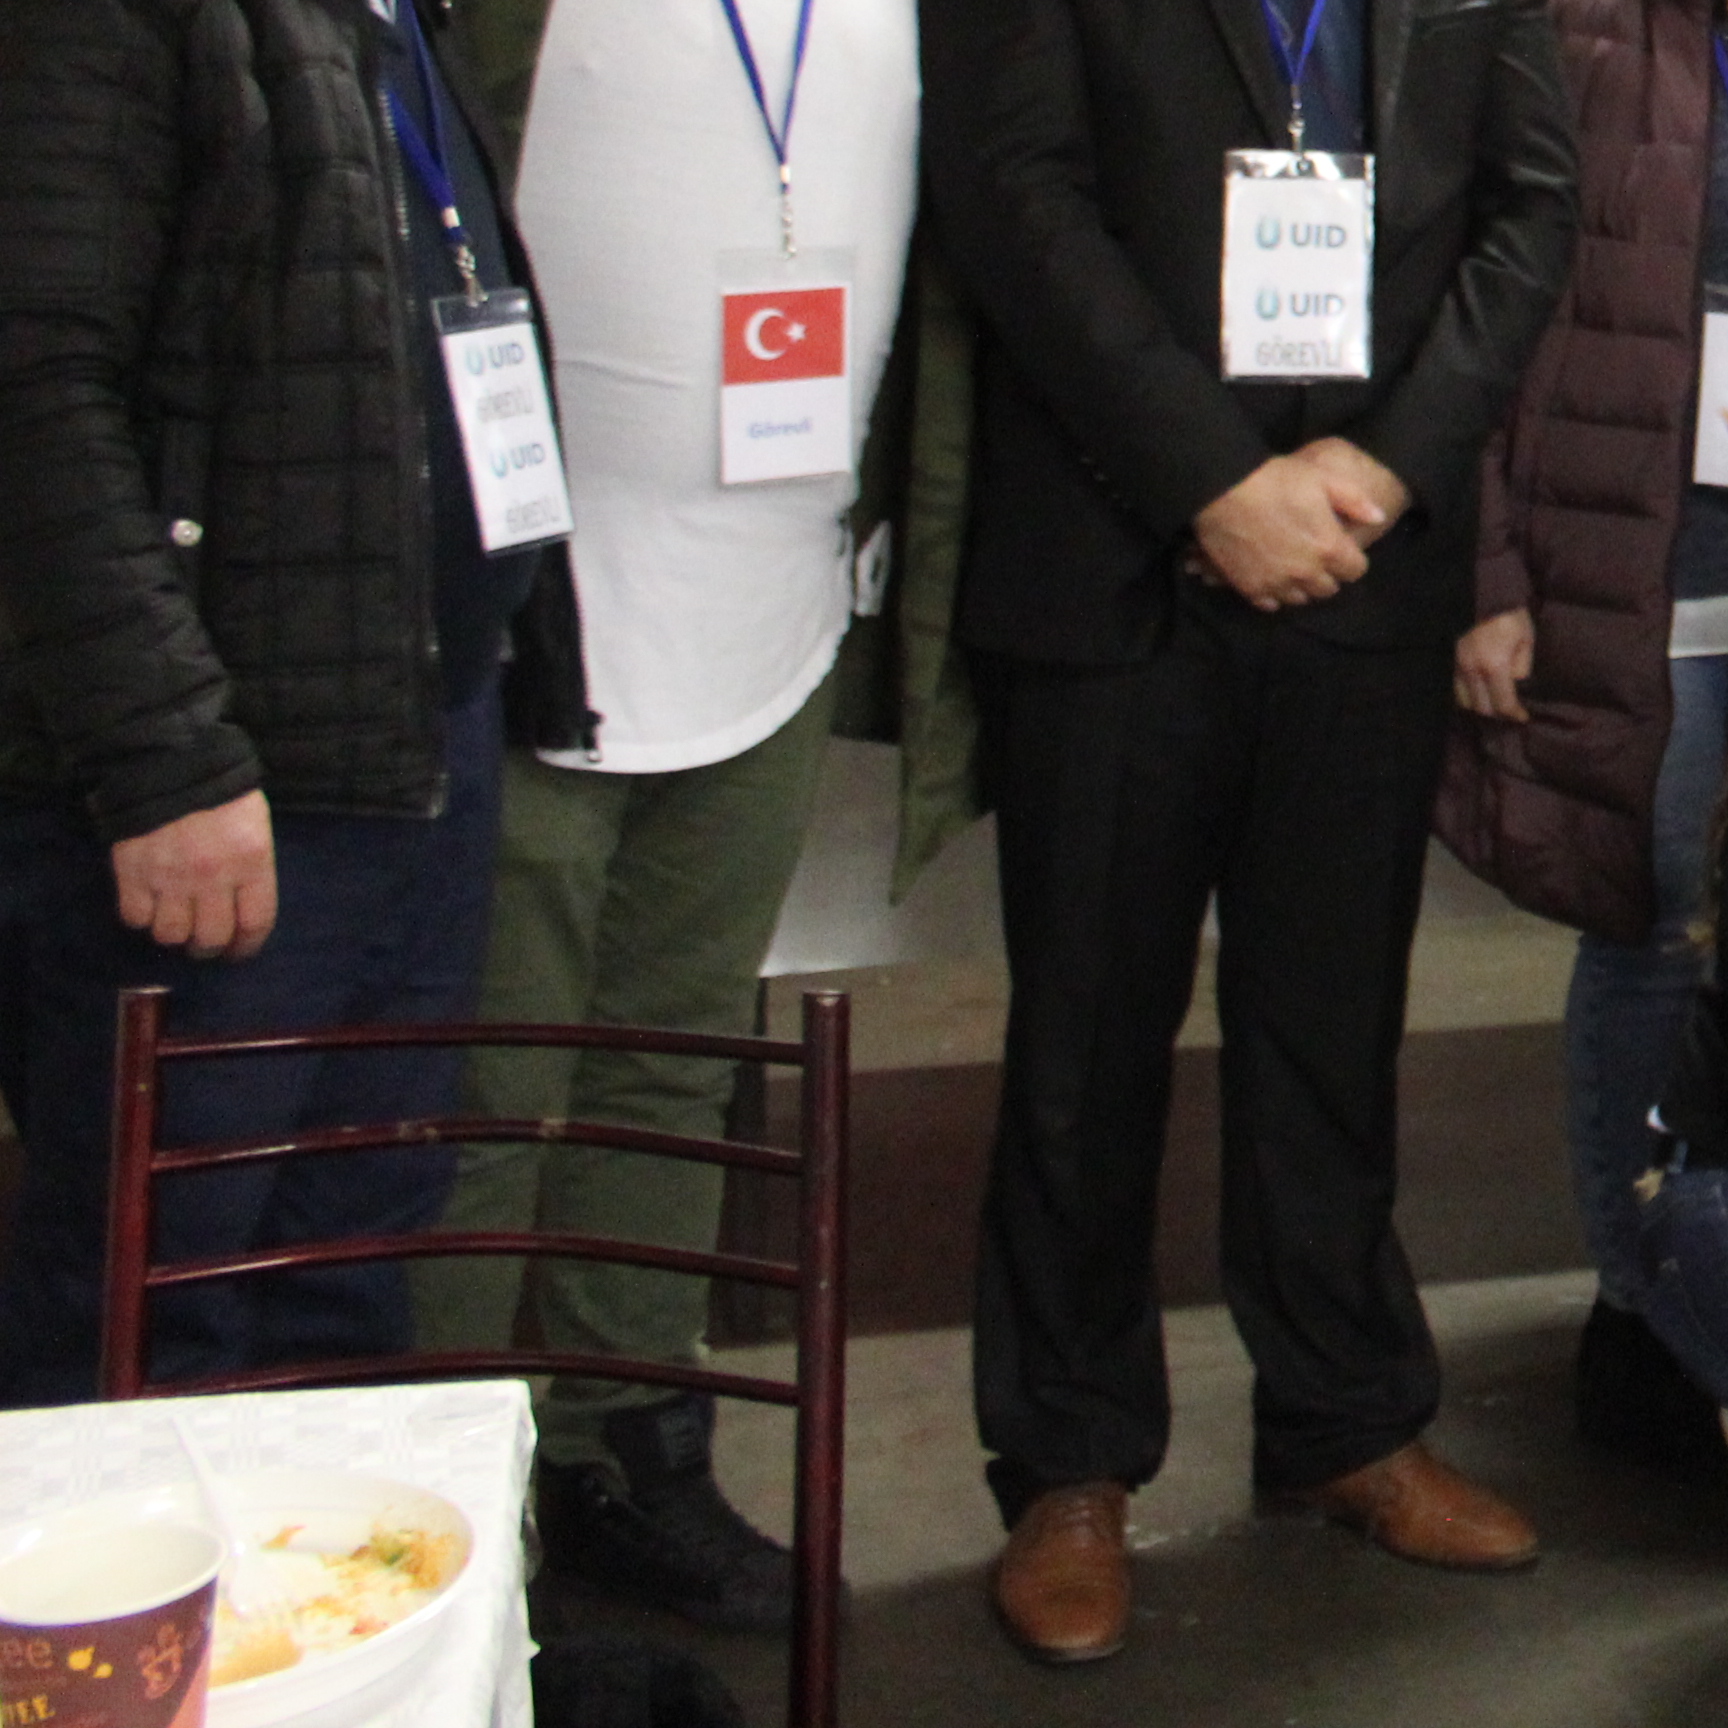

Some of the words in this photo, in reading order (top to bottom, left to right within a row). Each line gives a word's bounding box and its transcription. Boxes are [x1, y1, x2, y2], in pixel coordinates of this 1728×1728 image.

[1290, 224, 1348, 249] UID
[1290, 292, 1345, 317] UID
[491, 343, 525, 366] UID
[510, 444, 545, 470] UID
